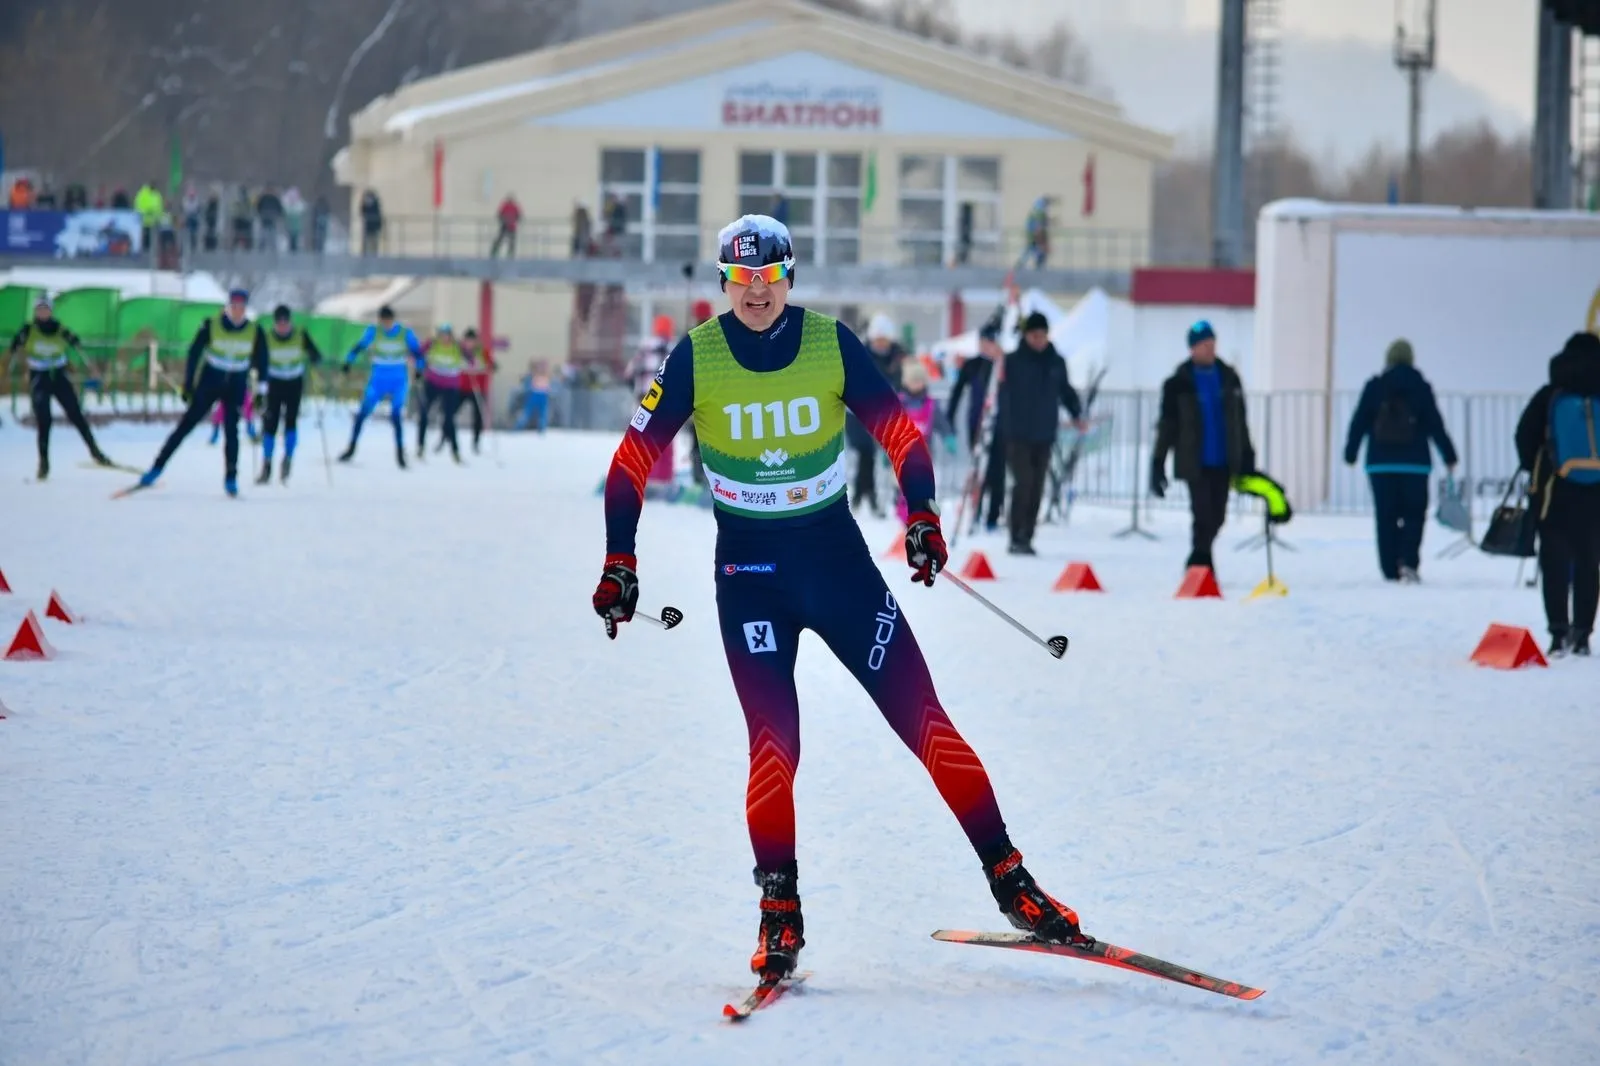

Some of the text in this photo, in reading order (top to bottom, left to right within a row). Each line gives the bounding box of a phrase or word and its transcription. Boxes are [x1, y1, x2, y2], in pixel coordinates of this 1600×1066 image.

[722, 102, 882, 127] БИАТЛОН
[740, 248, 758, 258] RACE
[723, 396, 820, 440] 1110
[755, 468, 796, 478] УФИМСКИЙ
[742, 490, 776, 499] RUSSIA
[868, 590, 897, 670] odlo
